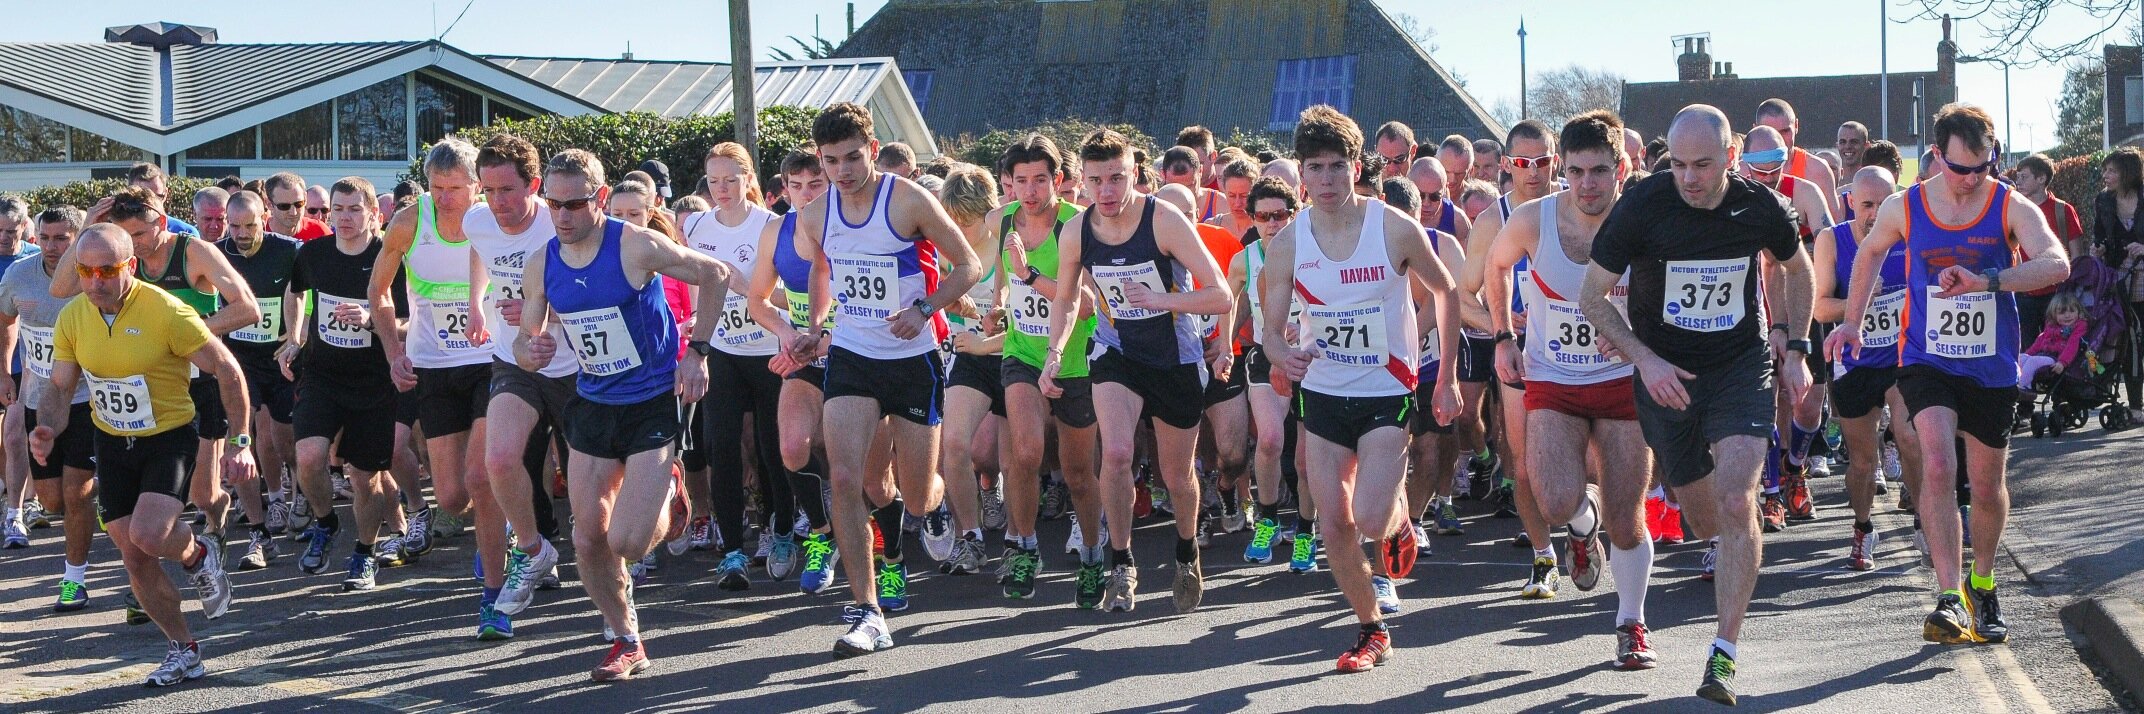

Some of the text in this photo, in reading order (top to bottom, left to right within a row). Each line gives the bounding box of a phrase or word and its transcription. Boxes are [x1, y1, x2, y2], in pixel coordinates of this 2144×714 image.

[834, 258, 855, 266] VICTORY
[1140, 266, 1154, 274] CLUB
[1339, 265, 1385, 284] HAVANT
[1671, 264, 1746, 274] VICTORY ATHLETIC CLUB
[844, 275, 886, 301] 339
[1680, 282, 1732, 310] 373
[1982, 293, 1993, 301] CLUB
[843, 304, 873, 317] SELSEY
[873, 309, 890, 319] 10K
[1310, 310, 1336, 318] VICTORY
[1337, 308, 1364, 318] ATHLETIC
[1365, 306, 1381, 314] CLUB
[1549, 304, 1573, 313] VICTORY
[1955, 302, 1971, 310] 2014
[580, 315, 604, 324] ATHLETIC
[604, 312, 619, 321] CLUB
[1116, 308, 1145, 318] SELSEY
[1674, 314, 1734, 329] SELSEY 10K
[1864, 308, 1900, 333] 361
[1939, 310, 1985, 336] 280
[584, 323, 598, 332] 2014
[235, 331, 259, 341] SELSEY
[324, 334, 364, 346] SELSEY 10K
[723, 330, 765, 345] SELSEY 10K
[1325, 324, 1370, 349] 271
[1864, 335, 1891, 346] SELSEY
[581, 331, 609, 357] 57
[1935, 342, 1987, 355] SELSEY 10K
[613, 357, 632, 371] 10K
[1325, 350, 1380, 365] SELSEY 10K
[1555, 351, 1590, 364] SELSEY
[94, 389, 138, 414] 359
[127, 419, 146, 430] 10K
